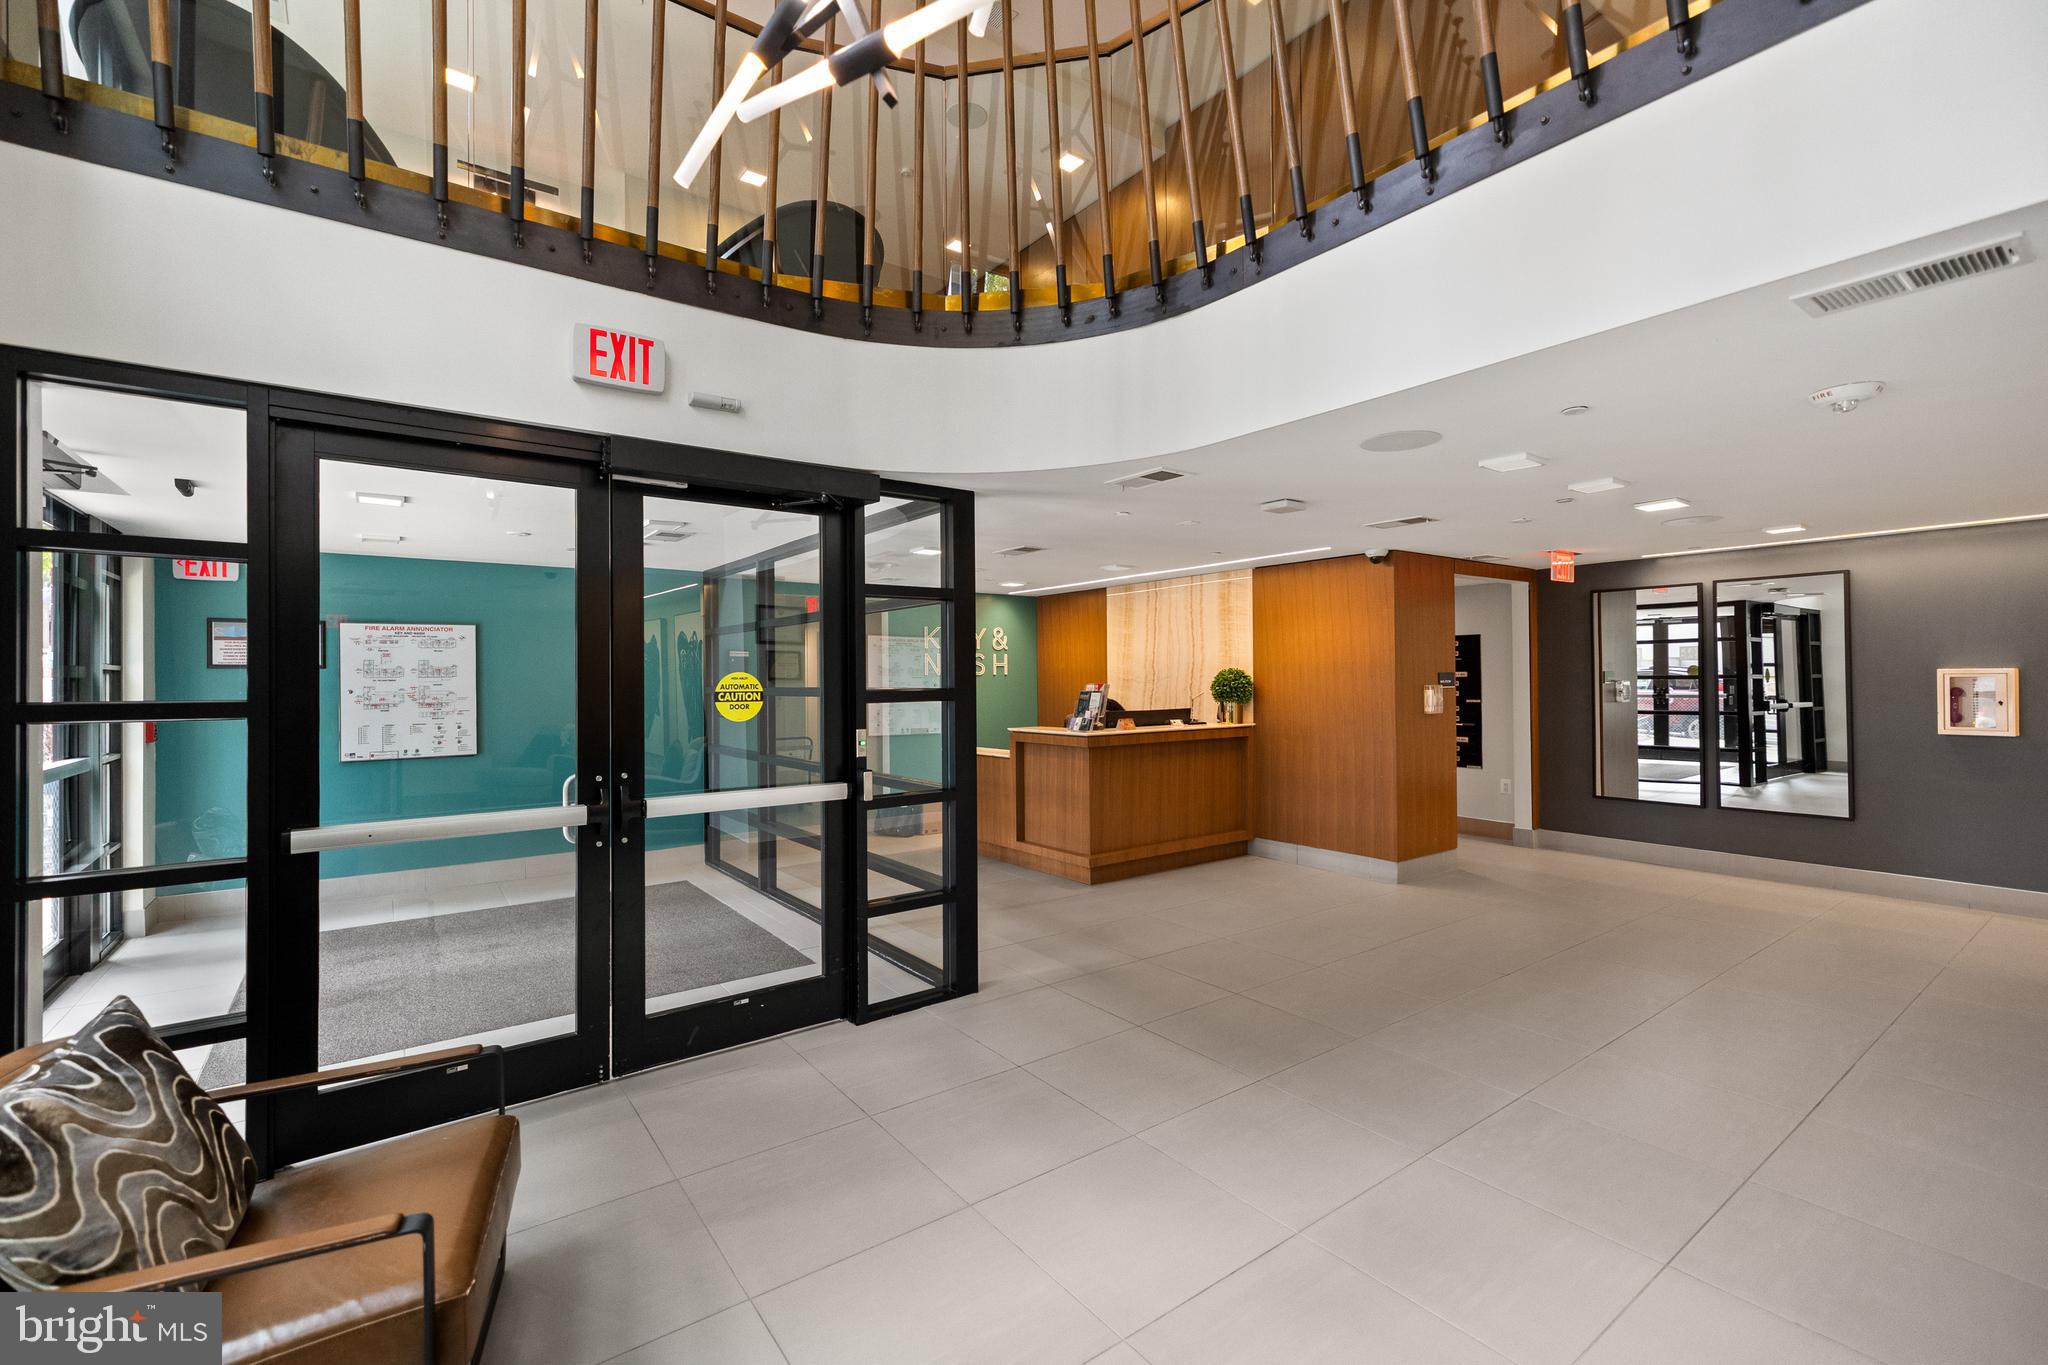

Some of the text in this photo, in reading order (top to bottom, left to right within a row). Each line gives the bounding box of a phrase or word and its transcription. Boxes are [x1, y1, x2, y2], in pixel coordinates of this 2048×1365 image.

[589, 328, 654, 385] EXIT
[923, 653, 1008, 676] NSH
[717, 692, 761, 701] CAUTION
